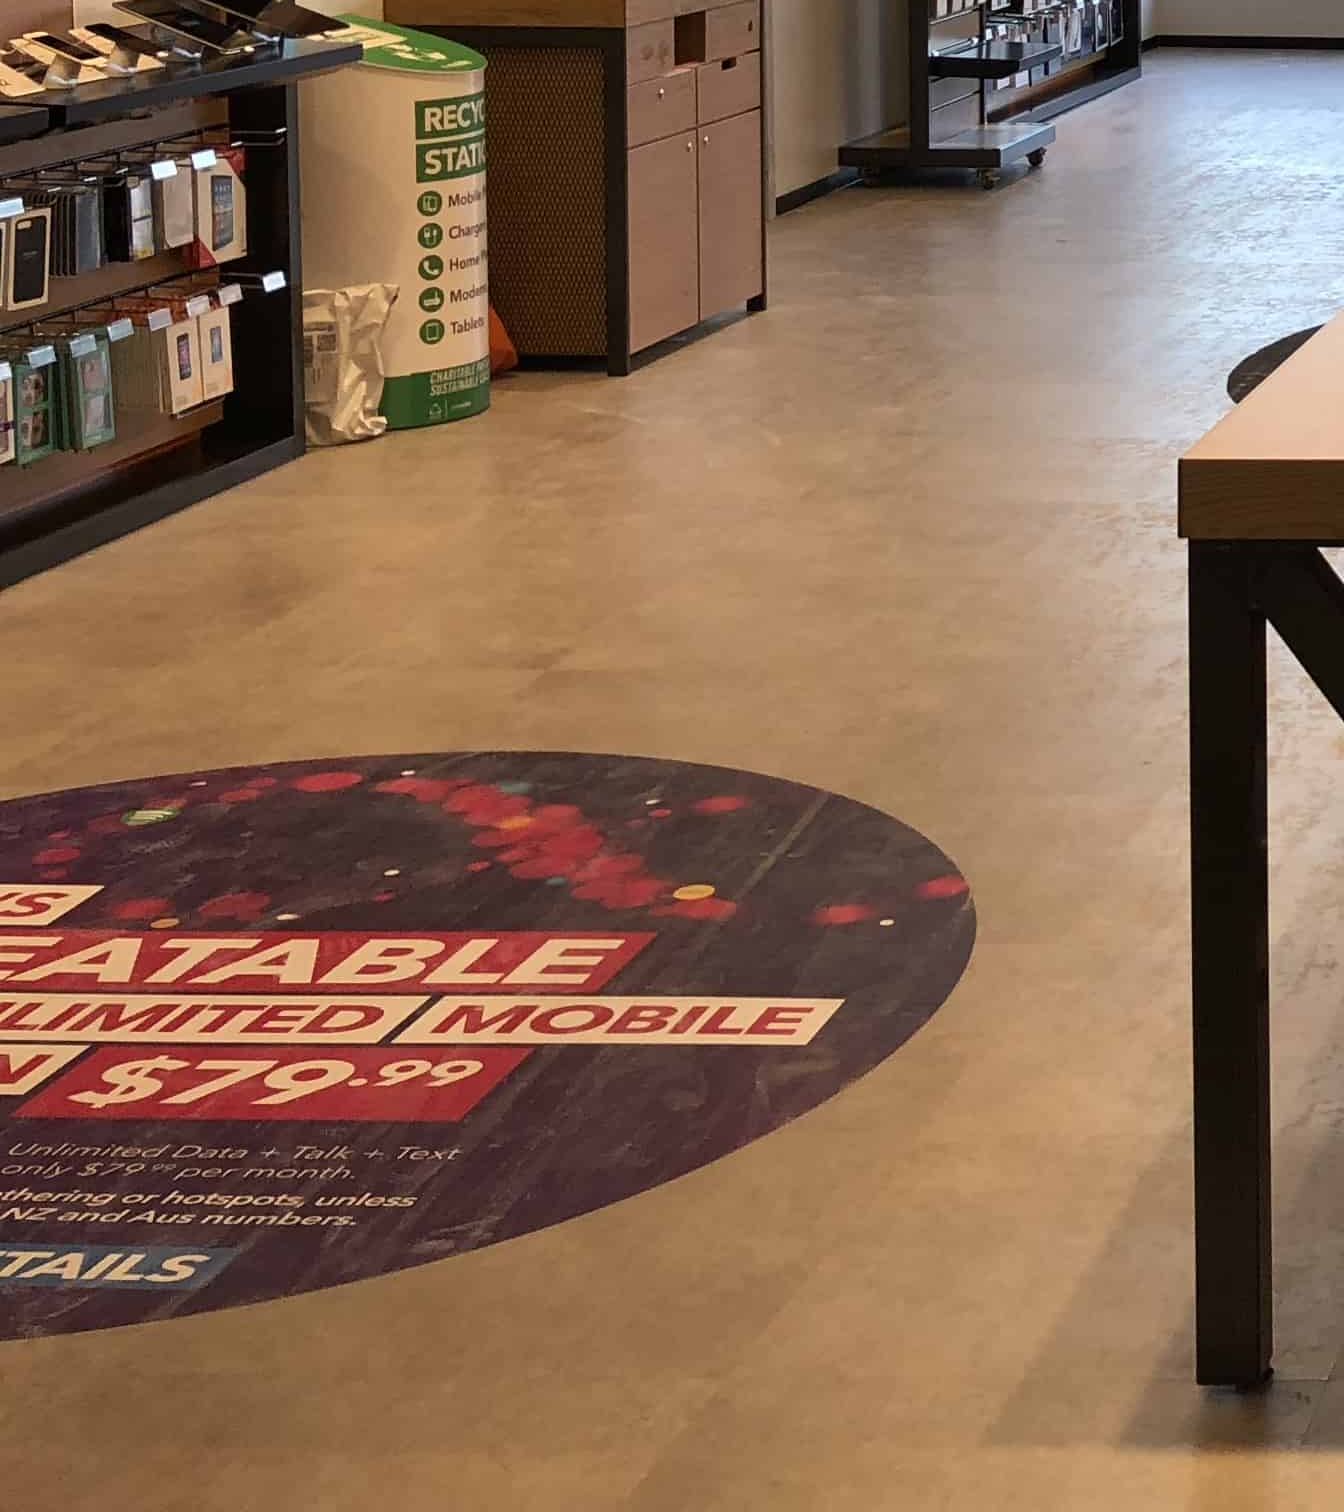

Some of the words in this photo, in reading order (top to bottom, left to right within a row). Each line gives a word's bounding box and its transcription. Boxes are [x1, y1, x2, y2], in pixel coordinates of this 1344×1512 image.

[431, 1004, 814, 1036] MOBILE
[9, 1142, 170, 1159] Unlimited
[172, 1145, 248, 1160] Data
[293, 1145, 353, 1161] Talk
[397, 1146, 463, 1161] Text
[1, 1161, 73, 1180] only
[173, 1167, 240, 1182] per
[242, 1165, 356, 1180] month.
[121, 1192, 161, 1206] or
[314, 1192, 418, 1208] unless
[57, 1209, 131, 1224] and
[127, 1210, 197, 1225] Aus
[201, 1211, 357, 1227] numbers.
[0, 1250, 212, 1283] TAILS
